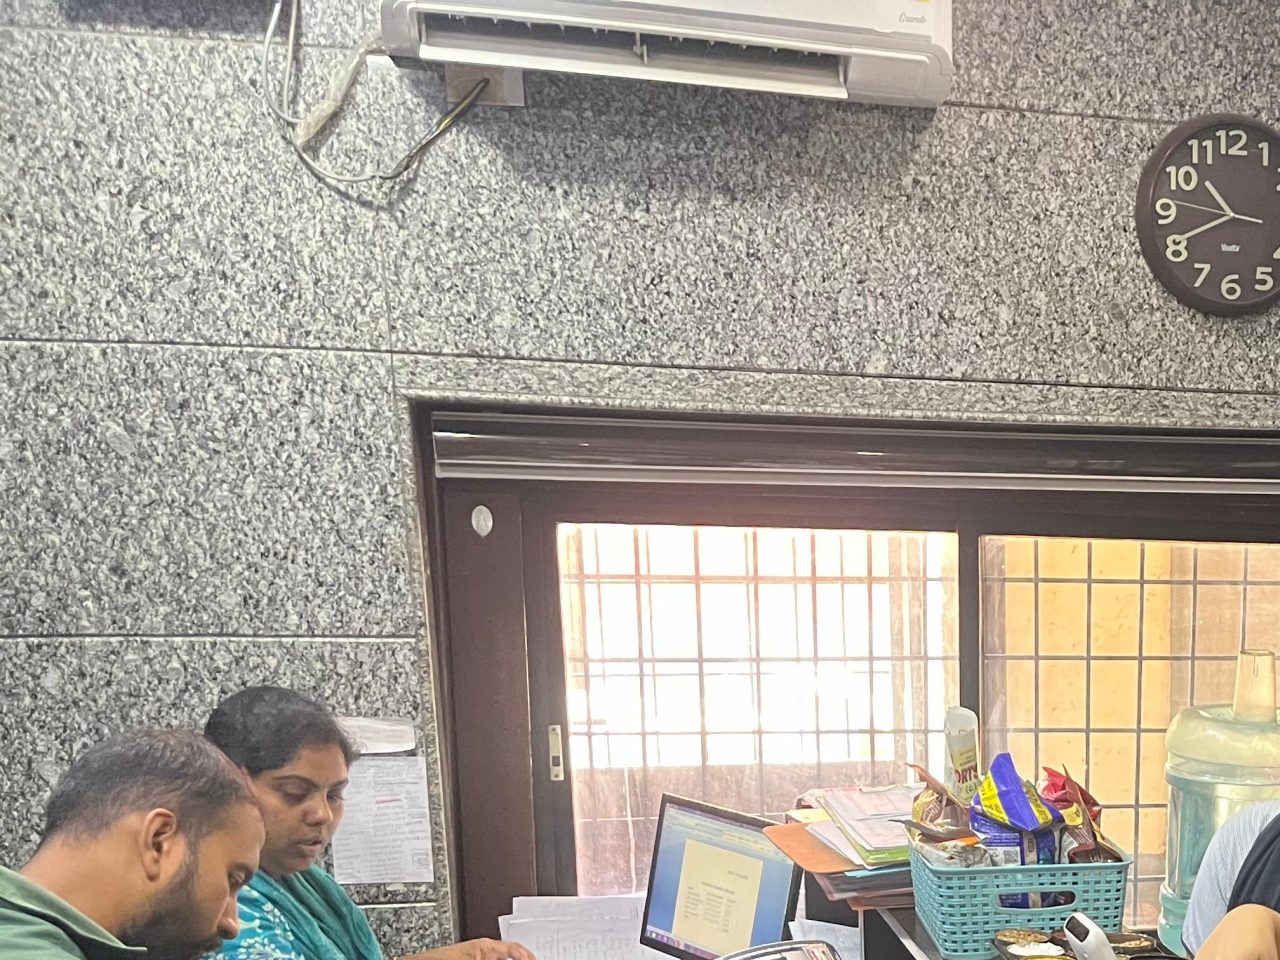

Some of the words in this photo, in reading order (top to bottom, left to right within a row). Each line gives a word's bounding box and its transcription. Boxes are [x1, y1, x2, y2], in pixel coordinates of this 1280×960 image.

[1188, 139, 1213, 165] 11
[1215, 130, 1248, 156] 12
[1258, 142, 1269, 167] 1
[1165, 165, 1198, 191] 10
[1155, 198, 1177, 225] 9
[1165, 234, 1188, 262] 8
[1193, 263, 1212, 287] 7
[1220, 274, 1241, 300] 6
[1254, 266, 1274, 291] 5
